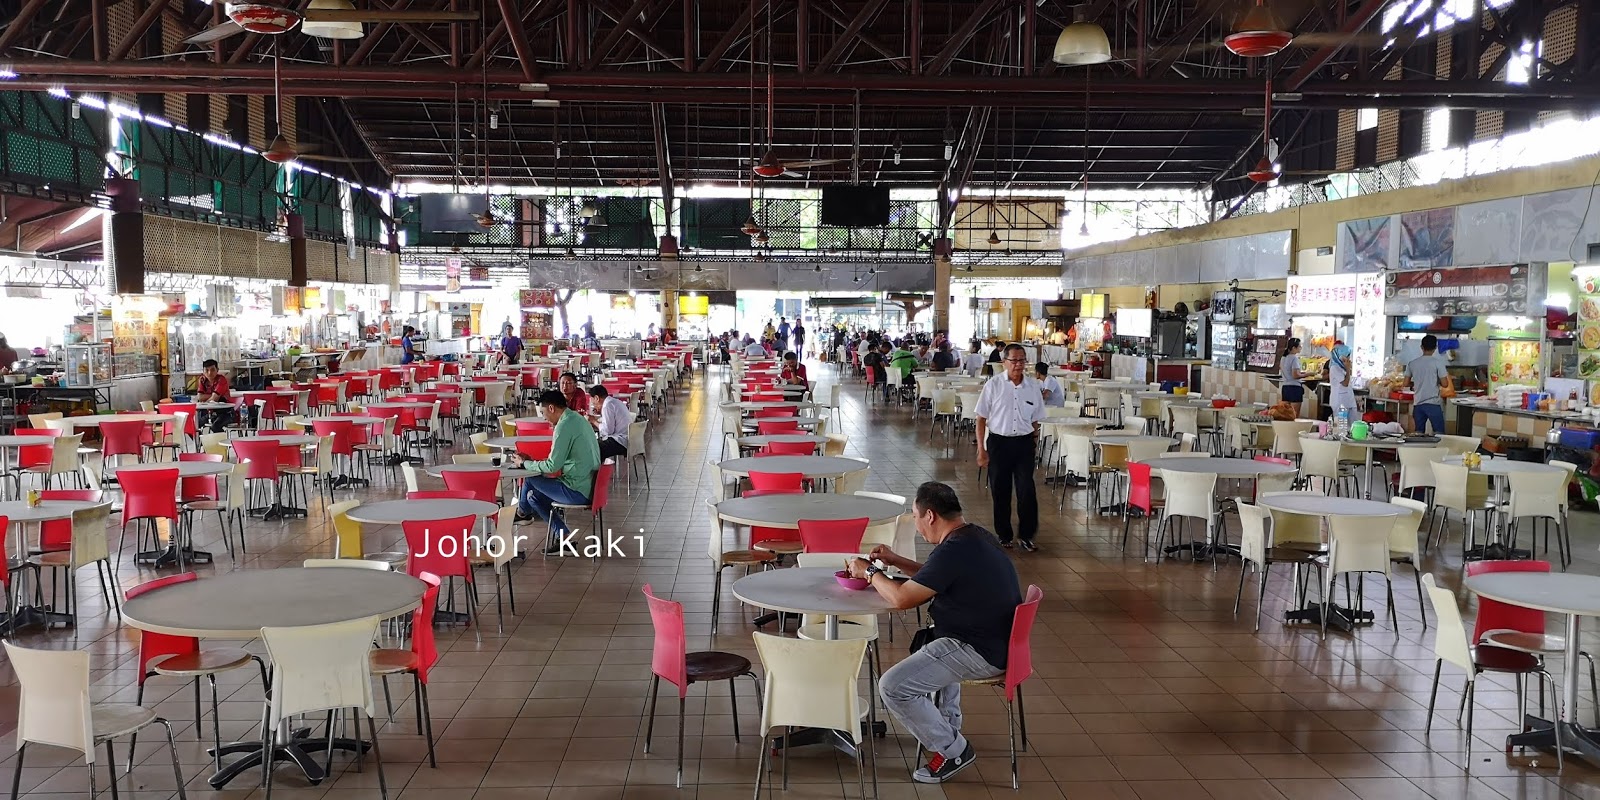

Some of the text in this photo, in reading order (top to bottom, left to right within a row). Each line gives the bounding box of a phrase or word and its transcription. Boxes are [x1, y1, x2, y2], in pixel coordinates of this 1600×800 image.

[1409, 284, 1493, 298] MASAKAN INDONESIA JAWA TIMUR
